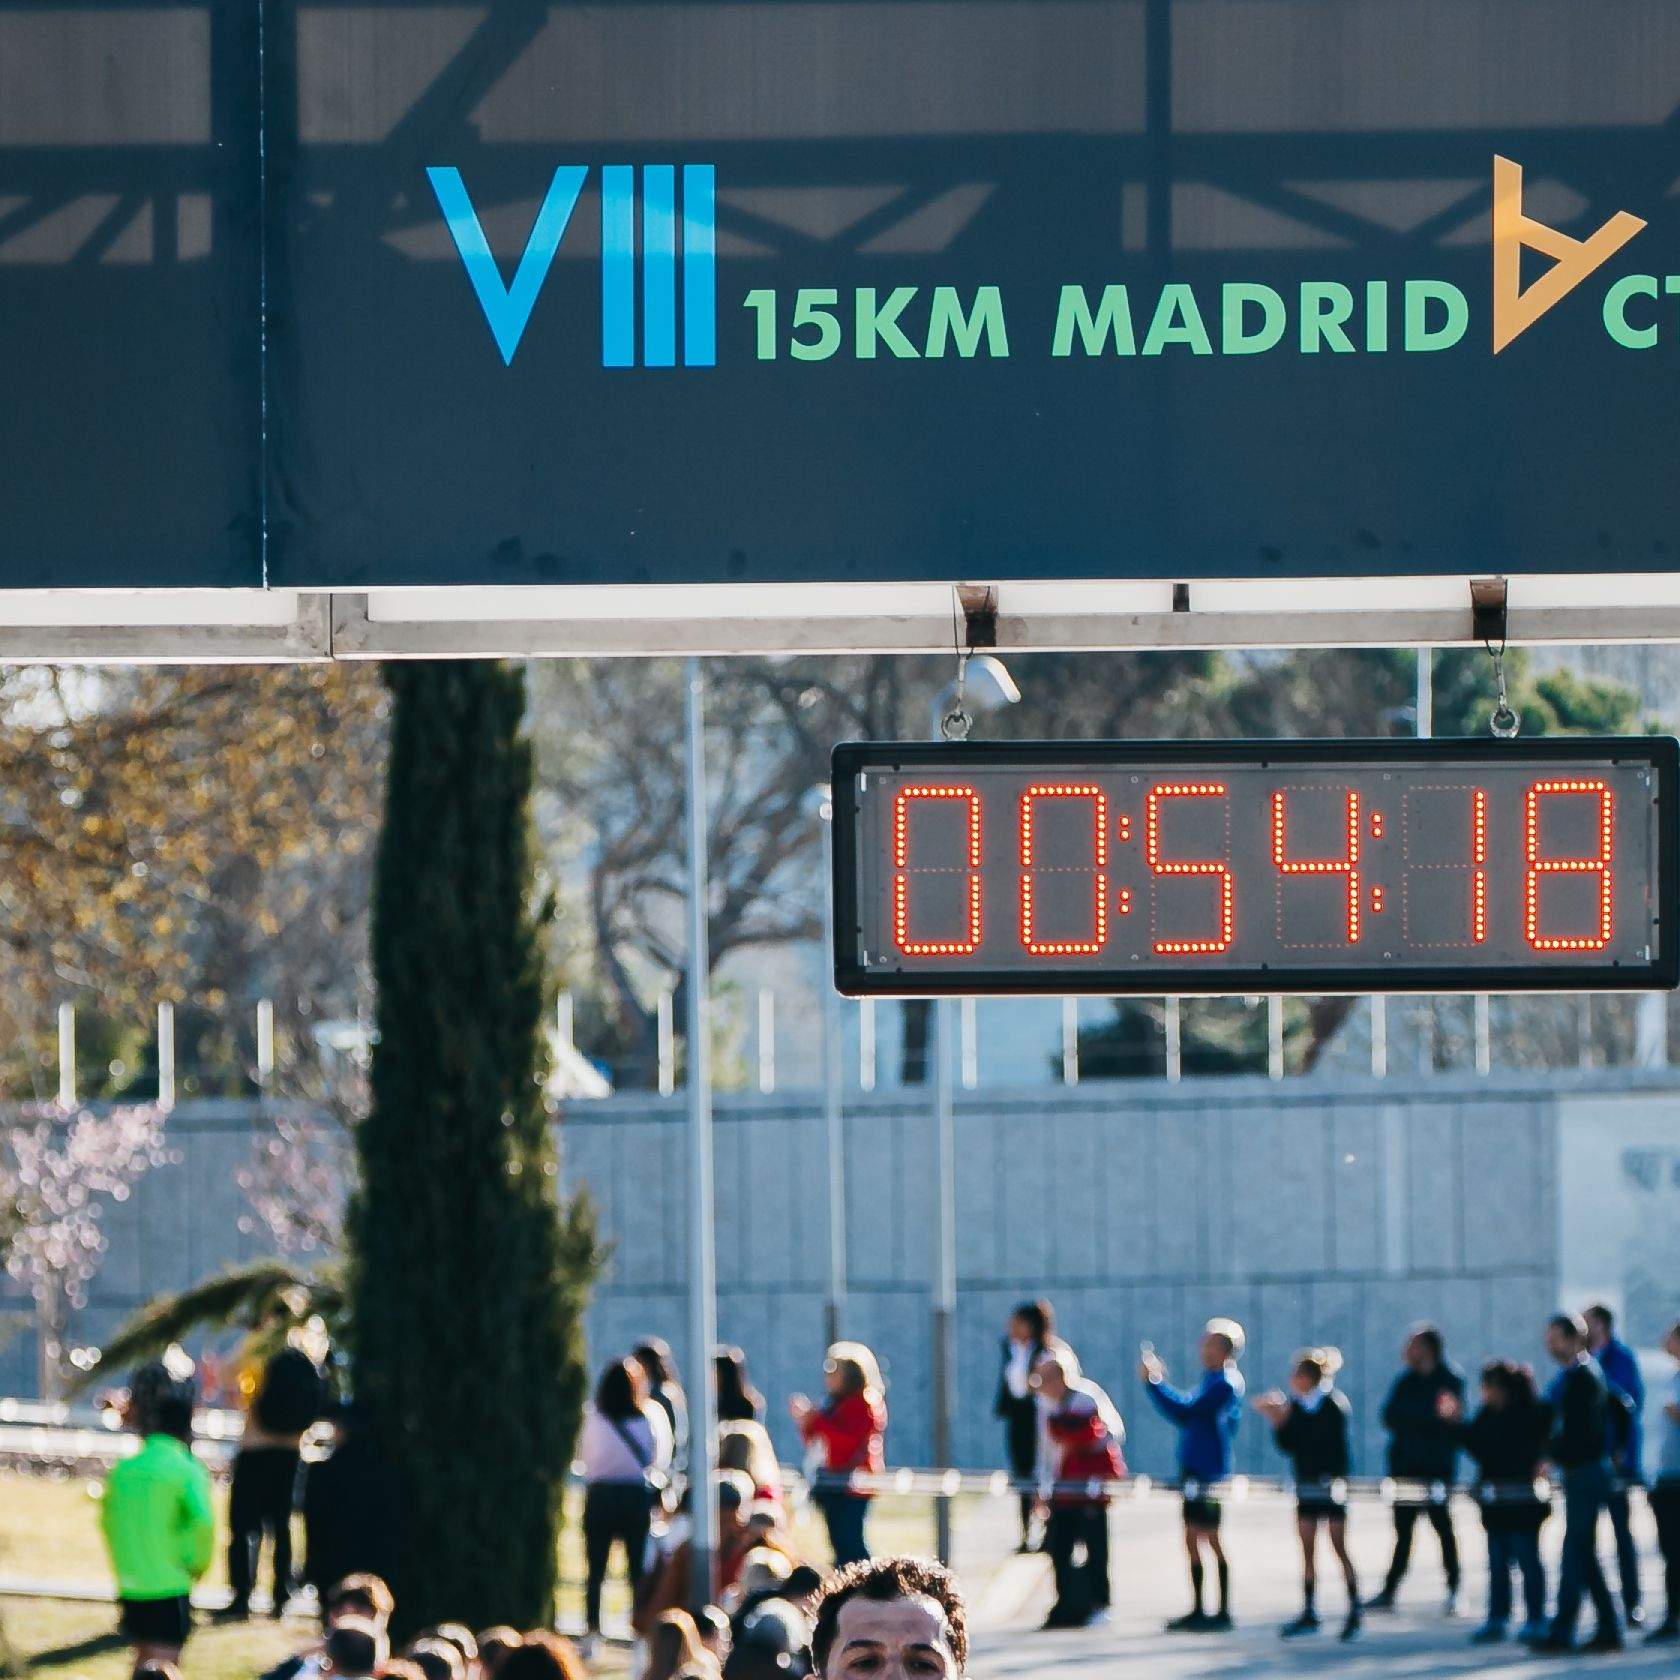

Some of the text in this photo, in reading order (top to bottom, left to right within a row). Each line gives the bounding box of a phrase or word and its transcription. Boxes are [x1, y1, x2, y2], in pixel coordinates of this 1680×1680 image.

[426, 164, 716, 367] VIII
[742, 286, 1010, 361] 15KM
[1052, 280, 1469, 358] MADRID
[894, 780, 1613, 955] 00:54:18
